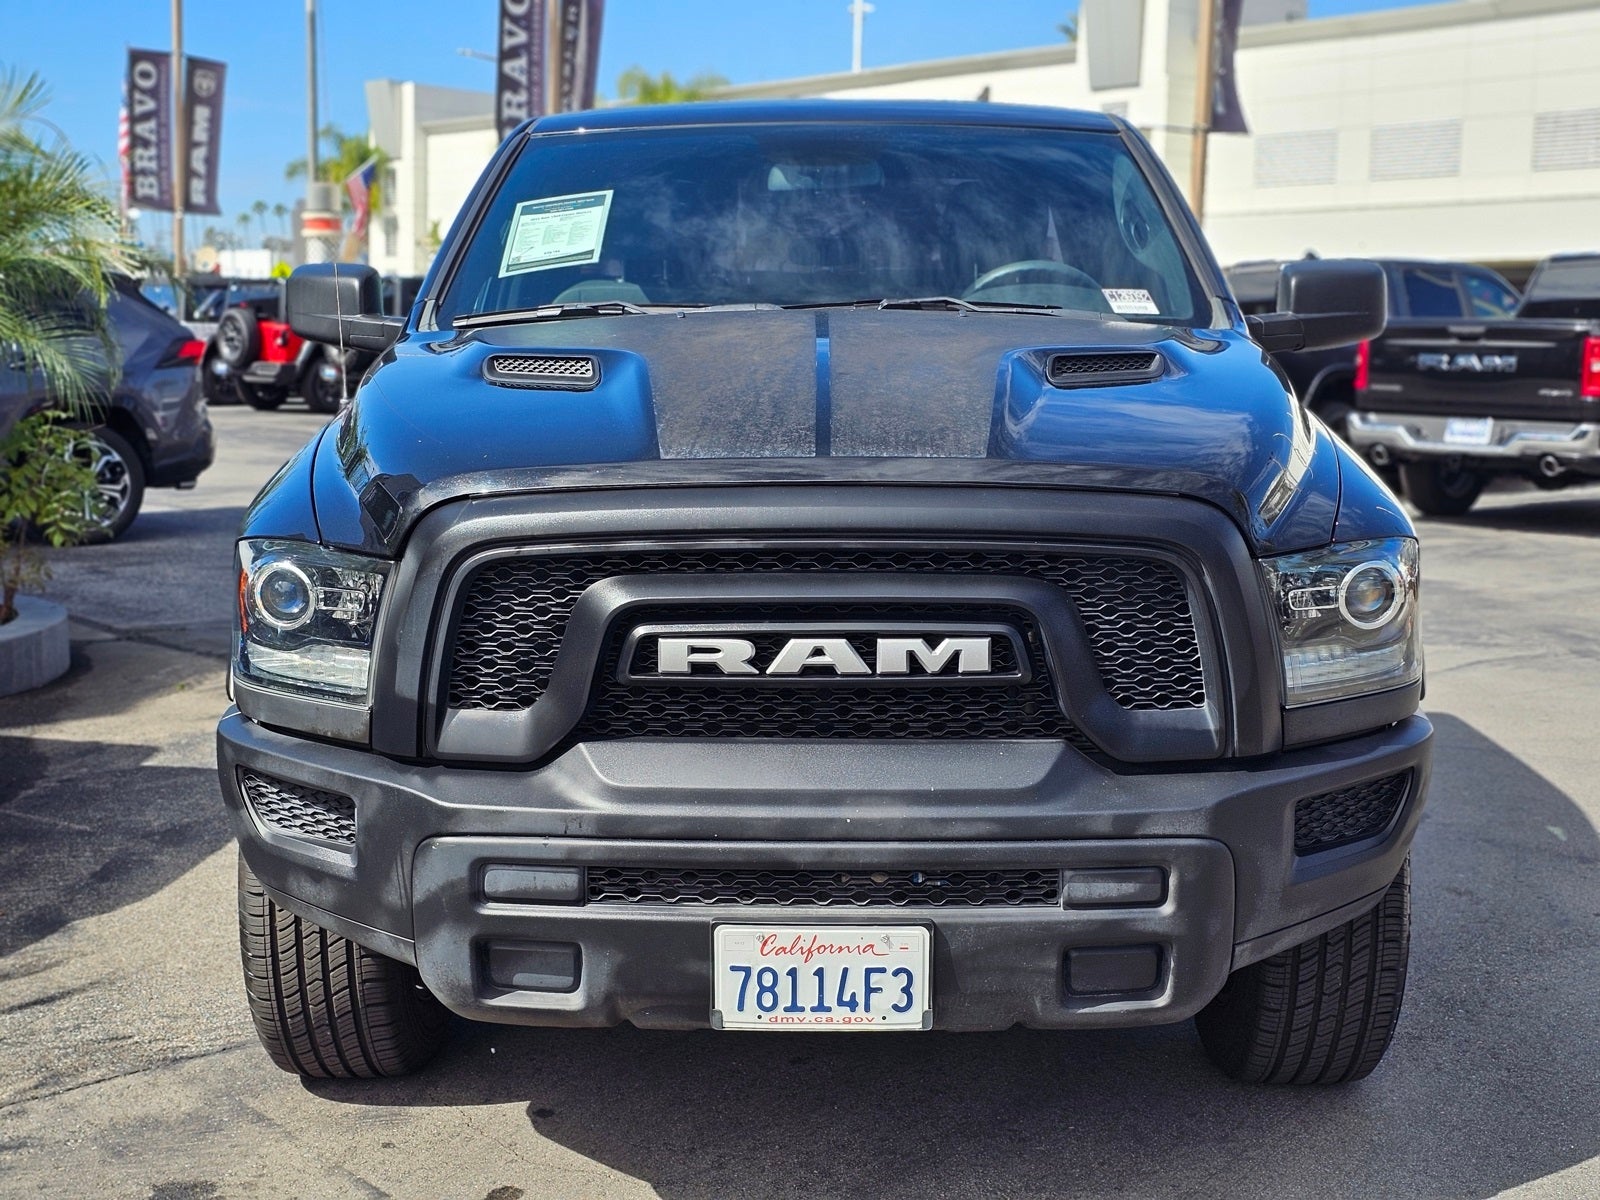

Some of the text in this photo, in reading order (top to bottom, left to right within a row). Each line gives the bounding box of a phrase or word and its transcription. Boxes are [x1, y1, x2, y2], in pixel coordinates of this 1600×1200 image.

[502, 0, 529, 137] RAV
[133, 59, 160, 200] BRAVO
[189, 105, 211, 206] RAM
[1416, 353, 1518, 373] RAM
[657, 636, 992, 675] RAM
[759, 933, 890, 964] California
[729, 965, 915, 1013] 78114F3
[768, 1015, 876, 1025] dmv.ca.gov
